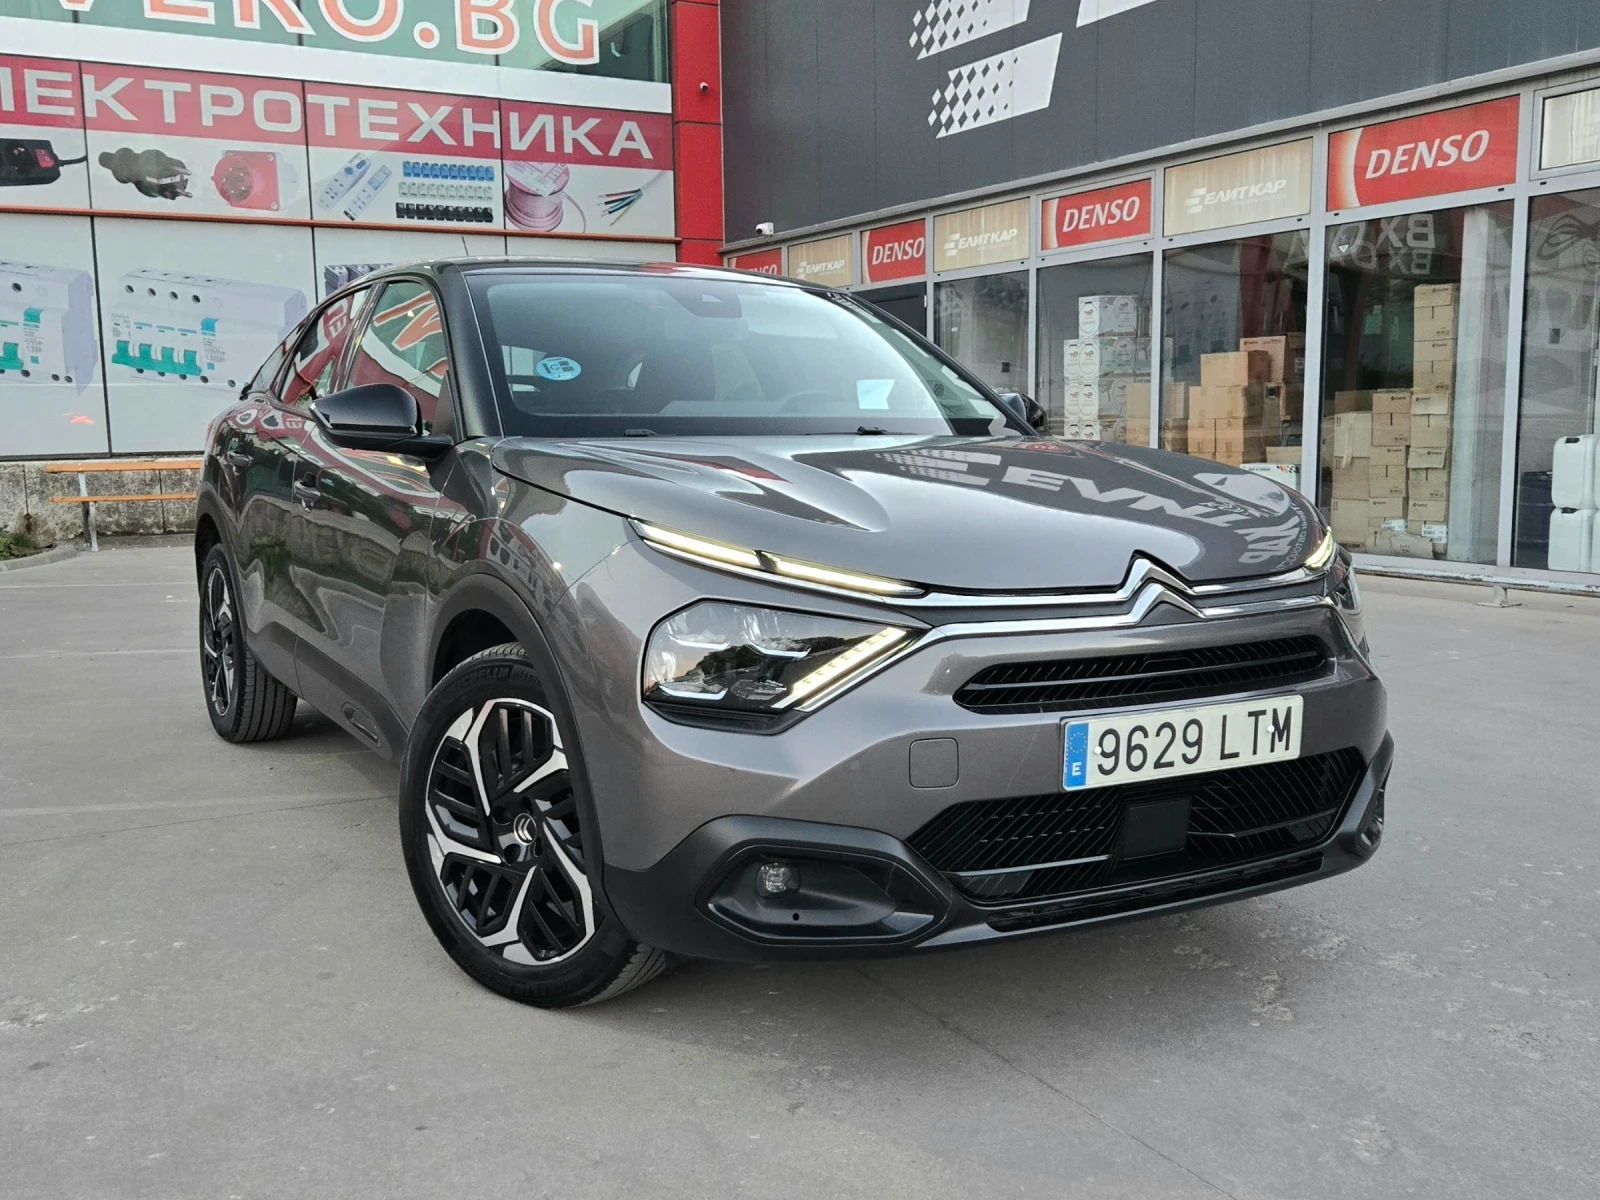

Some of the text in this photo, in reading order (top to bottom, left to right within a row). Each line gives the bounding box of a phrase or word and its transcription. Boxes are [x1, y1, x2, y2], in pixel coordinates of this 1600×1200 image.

[1365, 129, 1490, 180] DENSO
[1062, 196, 1140, 233] DENSO
[871, 237, 925, 266] DENSO
[1071, 706, 1293, 776] E 9629 LTM
